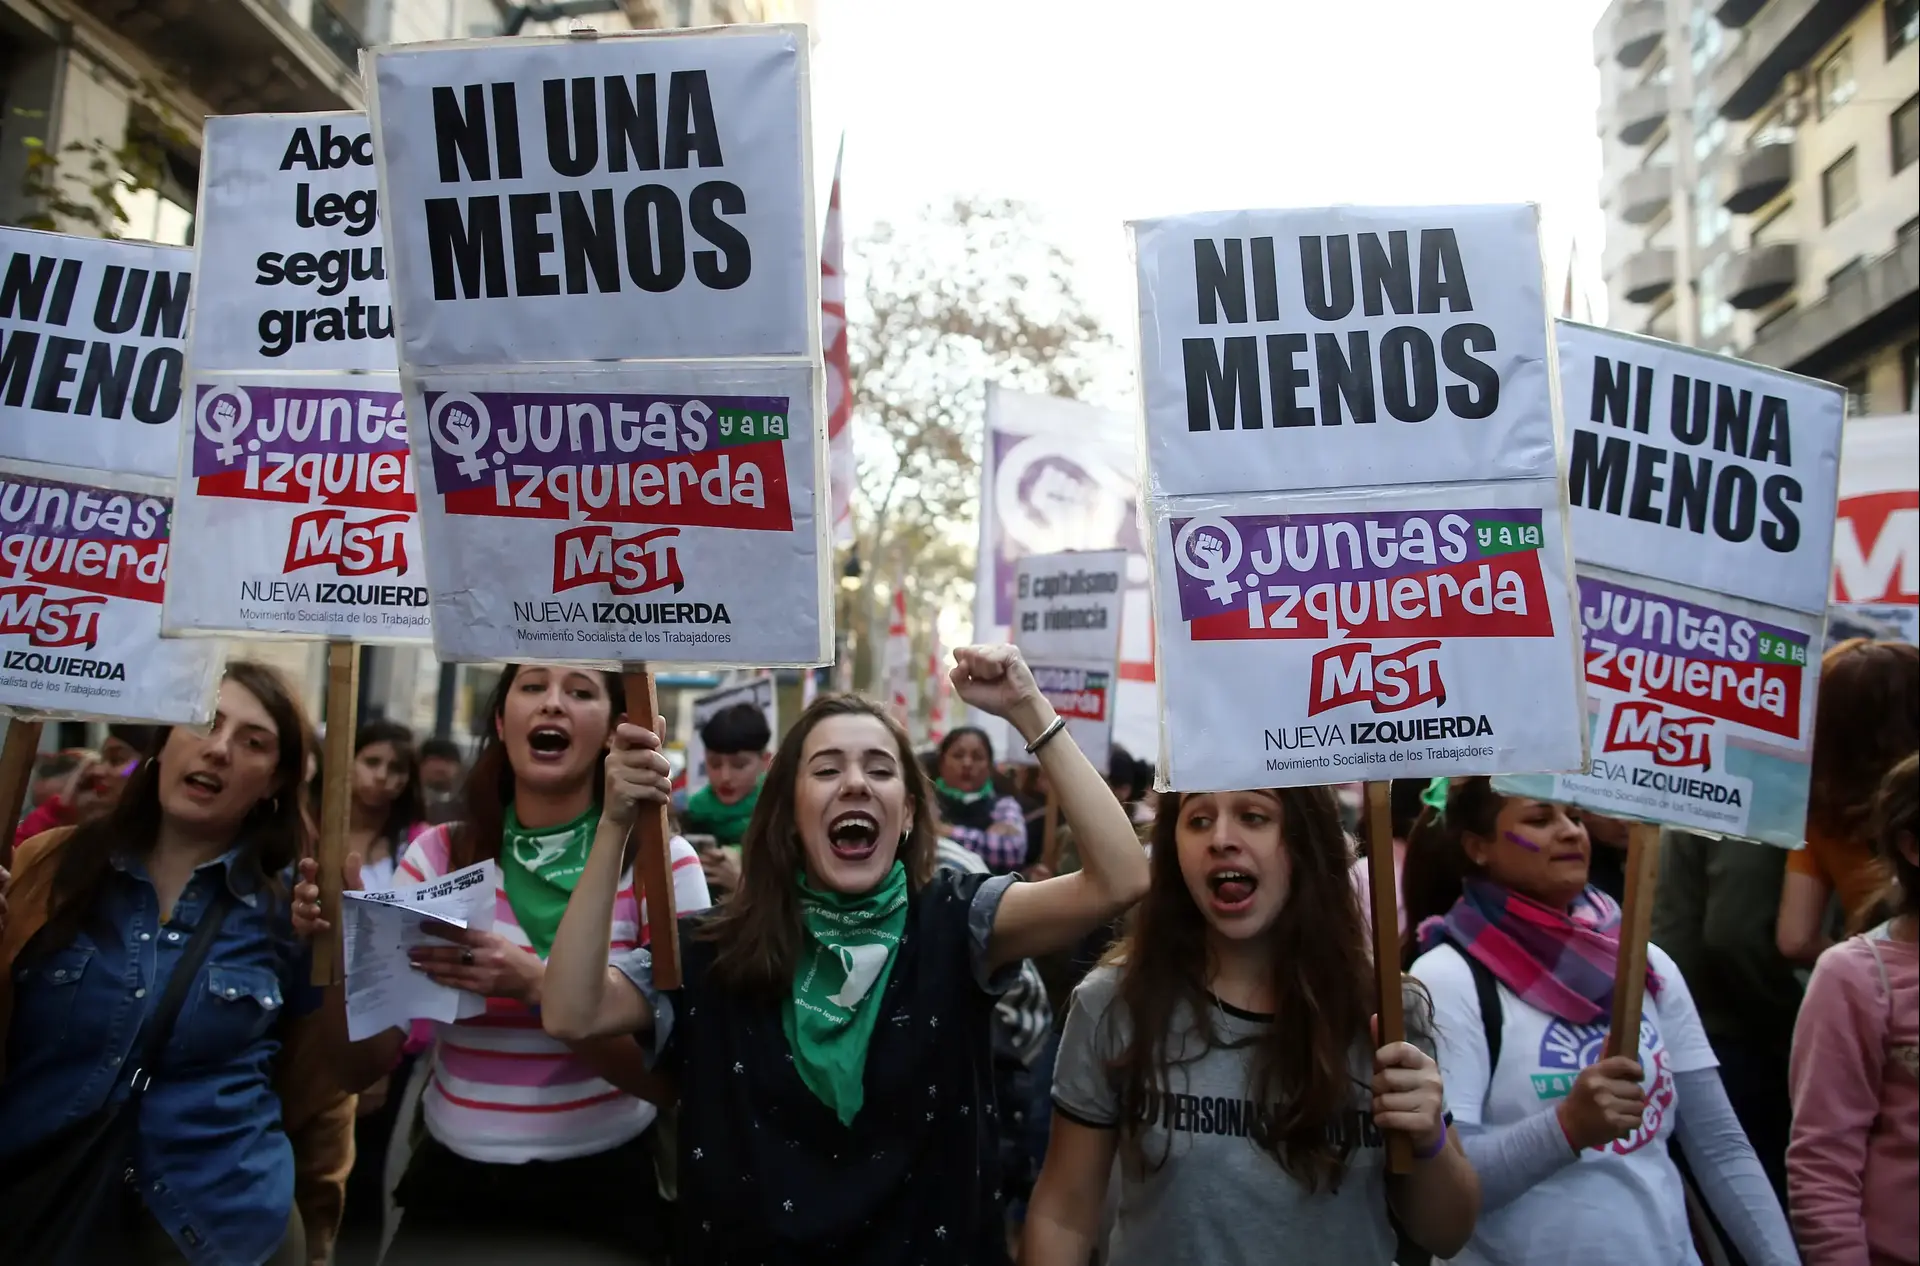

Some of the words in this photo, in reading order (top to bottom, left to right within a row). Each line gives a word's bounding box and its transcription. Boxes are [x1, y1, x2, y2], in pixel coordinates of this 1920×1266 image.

[433, 82, 522, 183] NI
[543, 70, 724, 177] UNA
[296, 183, 380, 236] leg
[424, 181, 752, 301] MENOS
[0, 252, 83, 326] NI
[93, 264, 192, 339] UN
[255, 246, 389, 296] segu
[1194, 236, 1279, 324] NI
[1299, 228, 1473, 321] UNA
[1182, 323, 1500, 432] MENOS
[719, 415, 733, 437] y
[741, 416, 755, 436] a
[763, 413, 784, 437] la
[1590, 356, 1654, 434] NI
[1671, 374, 1791, 467] UNA
[0, 481, 165, 539] untas
[491, 451, 765, 520] izquierda
[1569, 429, 1803, 553] MENOS
[0, 531, 168, 583] quierd
[295, 519, 406, 570] MST
[1477, 527, 1492, 547] y
[1499, 527, 1512, 546] a
[1519, 524, 1539, 545] la
[564, 536, 678, 589] MST
[0, 593, 100, 642] MST
[240, 608, 296, 621] Movimiento
[298, 610, 344, 622] Socialista
[347, 611, 359, 623] de
[363, 613, 377, 624] los
[241, 581, 310, 602] NUEVA
[514, 602, 586, 624] NUEVA
[593, 603, 731, 625] IZQUIERDA
[1245, 564, 1528, 638] izquierda
[518, 629, 574, 642] Movimiento
[577, 629, 626, 643] Socialista
[629, 630, 643, 643] de
[645, 630, 660, 643] los
[664, 630, 731, 645] Trabajadores
[1760, 638, 1771, 654] y
[1774, 642, 1786, 659] a
[0, 676, 27, 687] ialista
[30, 679, 44, 690] de
[47, 682, 60, 691] los
[64, 682, 121, 698] Trabajadores
[3, 650, 125, 681] IZQUIERDA
[1320, 650, 1438, 705] MST
[1583, 638, 1785, 717] zquierda
[1265, 725, 1345, 750] NUEVA
[1350, 715, 1493, 744] IZQUIERDA
[1266, 756, 1330, 771] Movimiento
[1333, 752, 1386, 766] Socialista
[1389, 750, 1403, 764] de
[1406, 748, 1423, 761] los
[1425, 745, 1494, 763] Trabajadores
[1613, 708, 1707, 762] MST
[1590, 759, 1627, 783] EVA
[1632, 767, 1742, 808] IZQUIERDA
